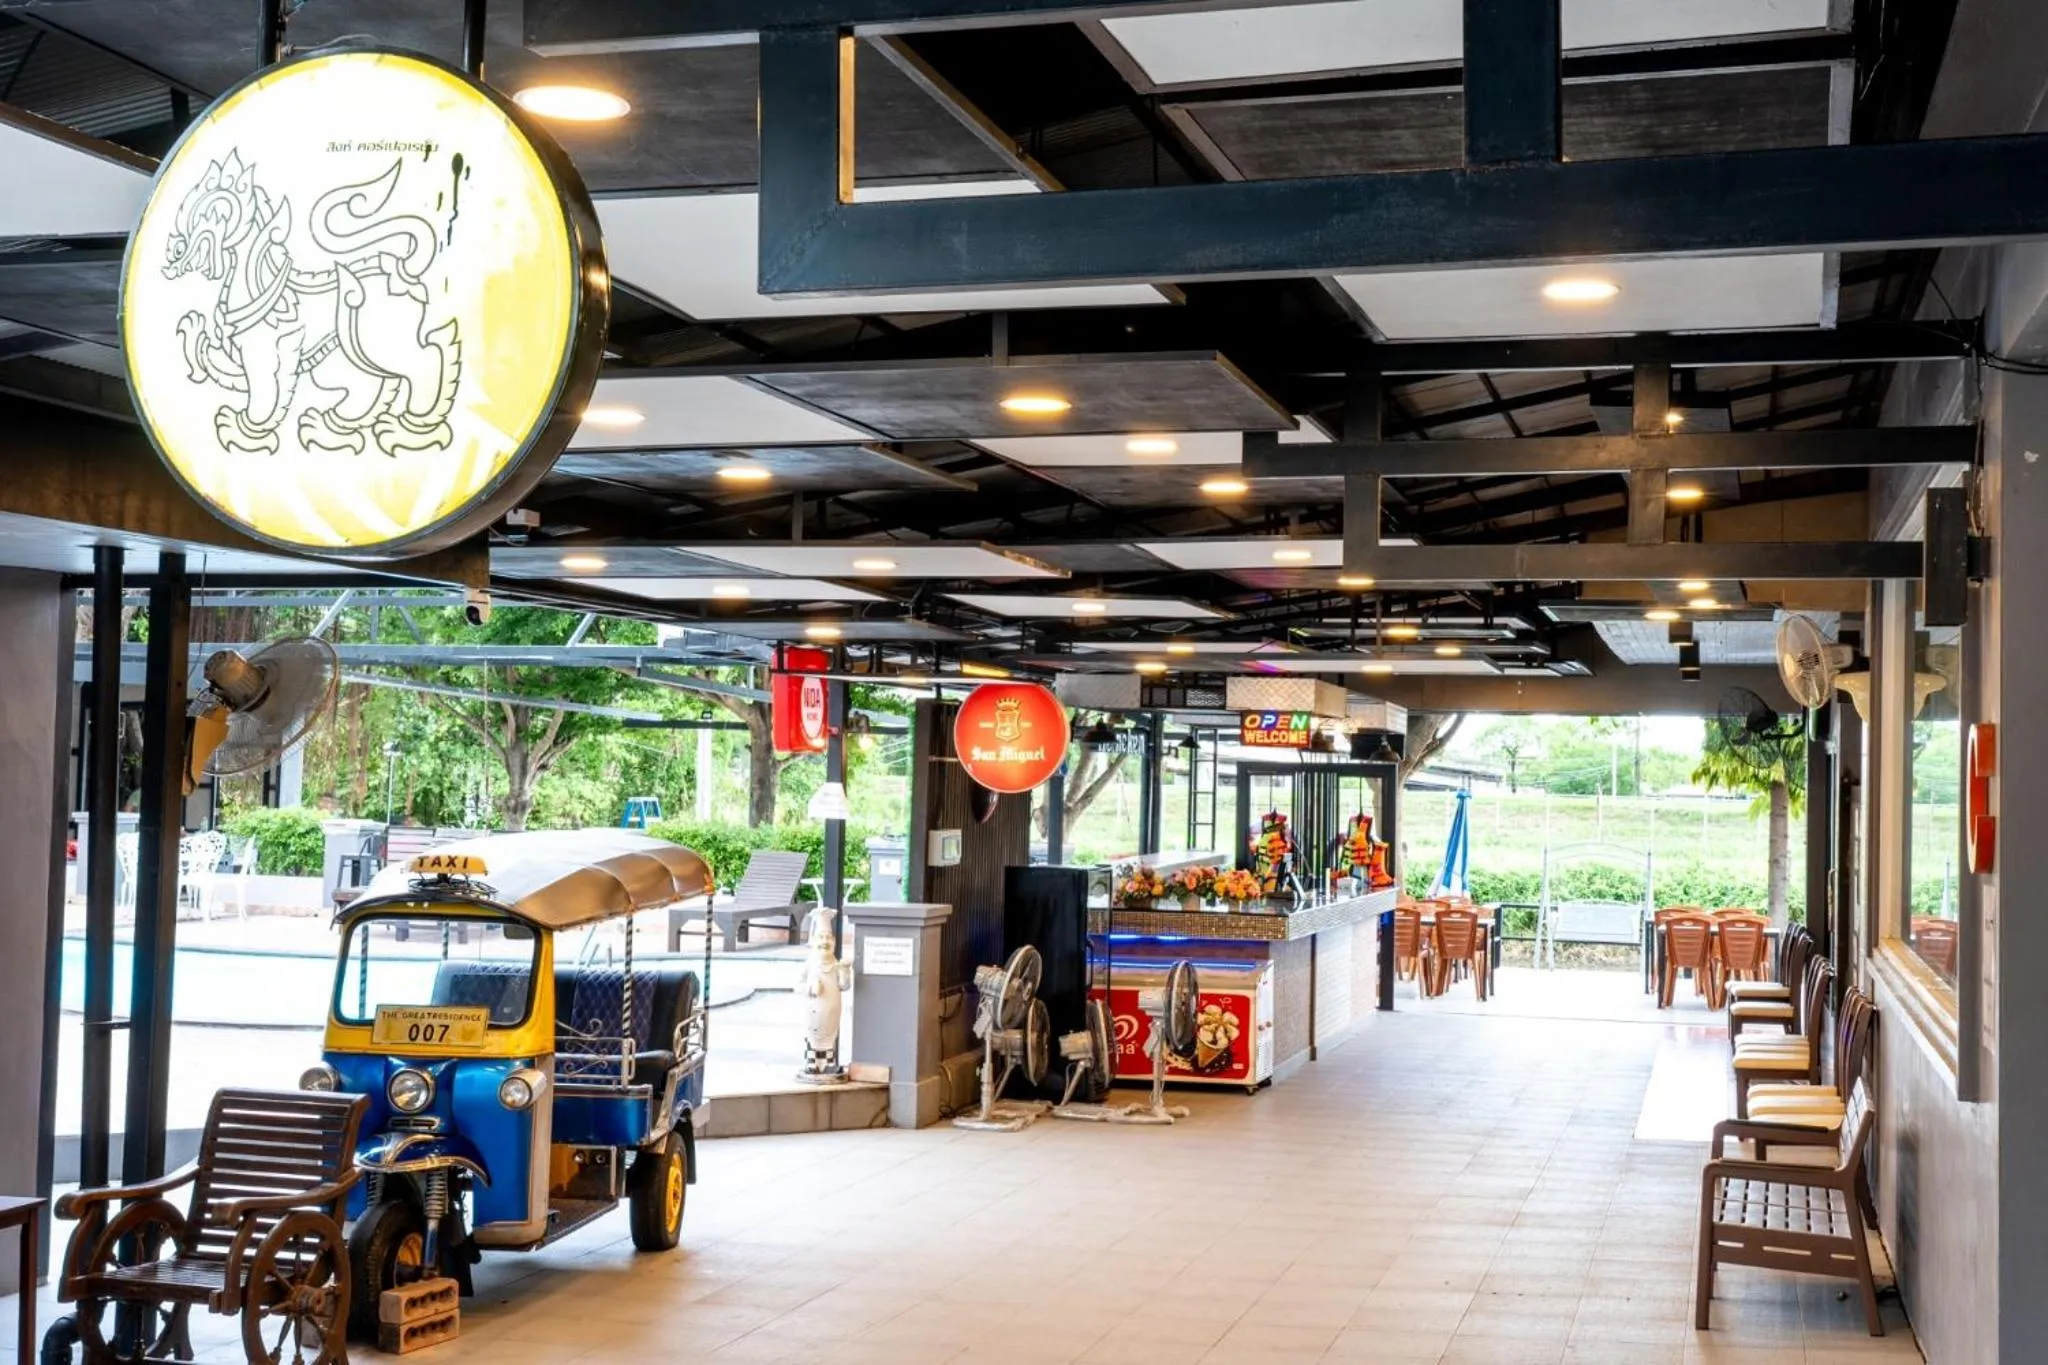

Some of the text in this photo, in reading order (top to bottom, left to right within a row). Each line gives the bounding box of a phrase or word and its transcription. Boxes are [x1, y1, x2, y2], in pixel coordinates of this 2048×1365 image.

[1244, 714, 1308, 730] OPEN
[1244, 729, 1308, 745] WELCOME
[971, 745, 1045, 764] San Miguel
[417, 855, 468, 869] TAXI
[408, 1023, 450, 1042] 007
